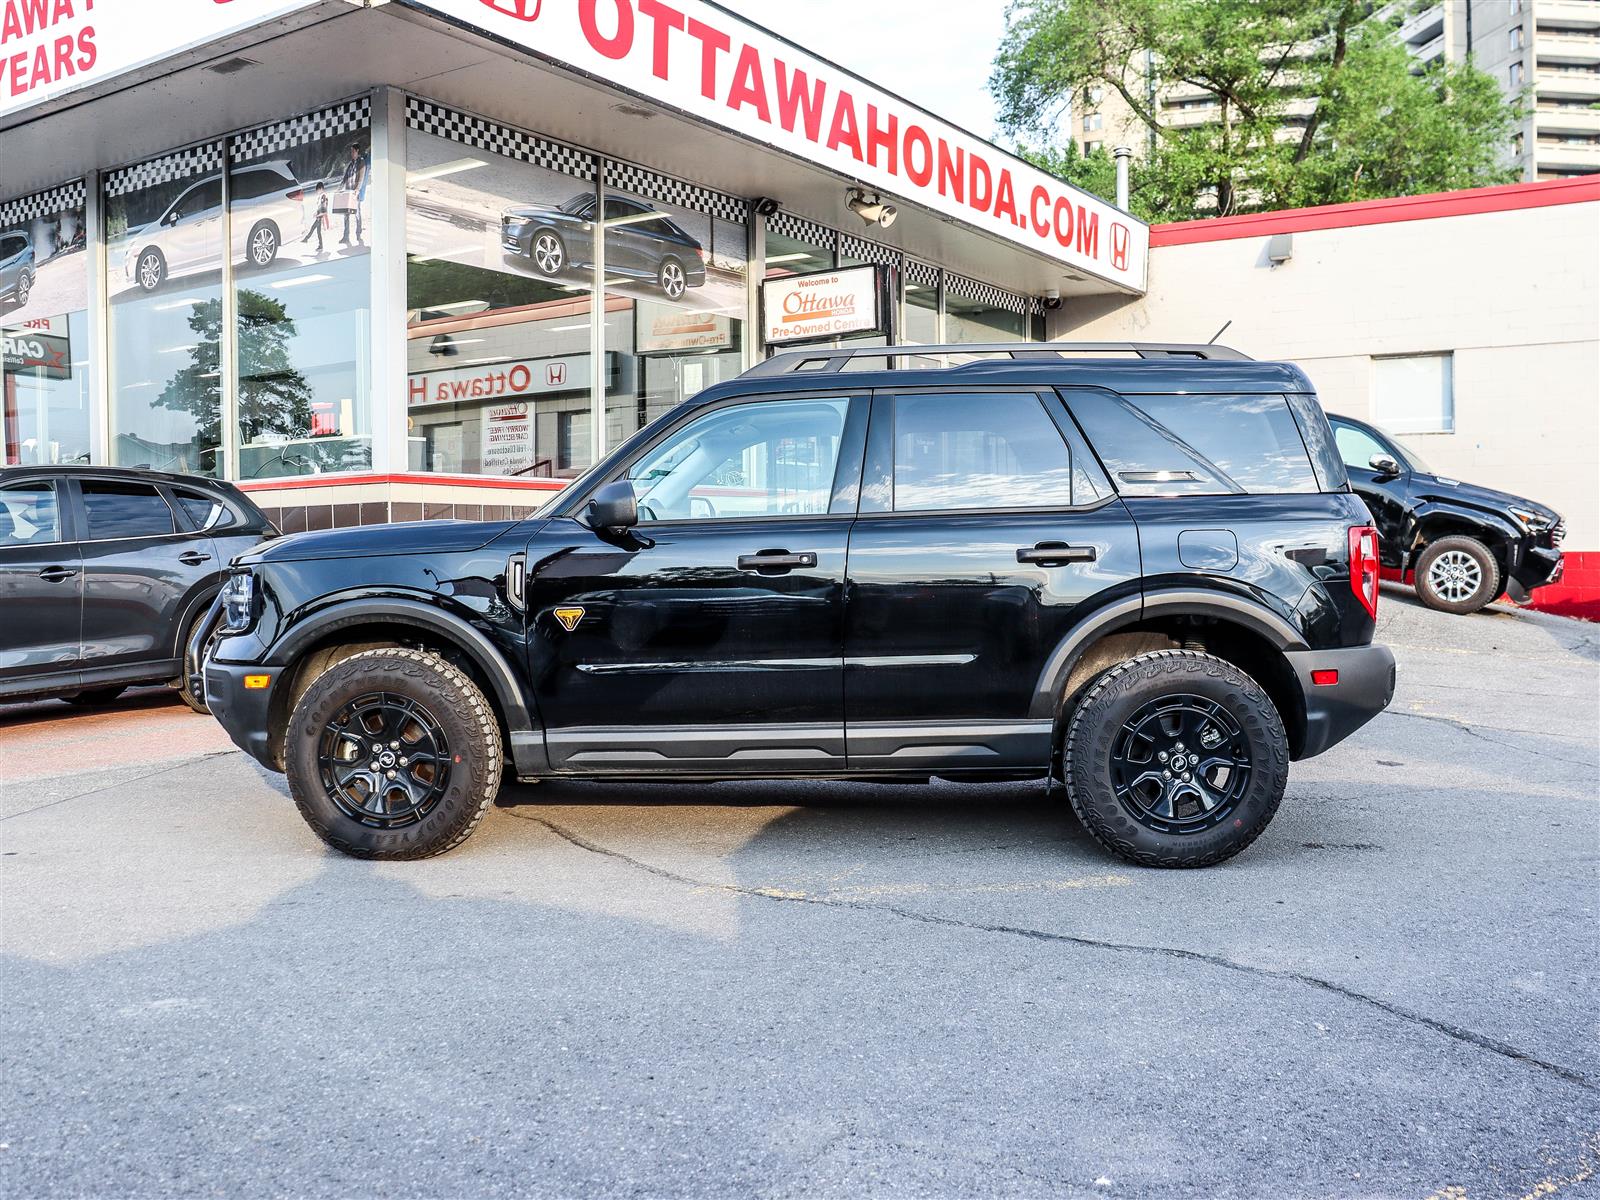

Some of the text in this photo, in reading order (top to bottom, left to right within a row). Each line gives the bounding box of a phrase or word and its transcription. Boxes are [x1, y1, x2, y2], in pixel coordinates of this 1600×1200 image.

[578, 0, 1098, 260] OTTAWAHONDA.COM
[797, 276, 839, 288] Welcome to
[782, 291, 856, 315] Ottawa
[772, 318, 871, 337] Pre-Owned Centre
